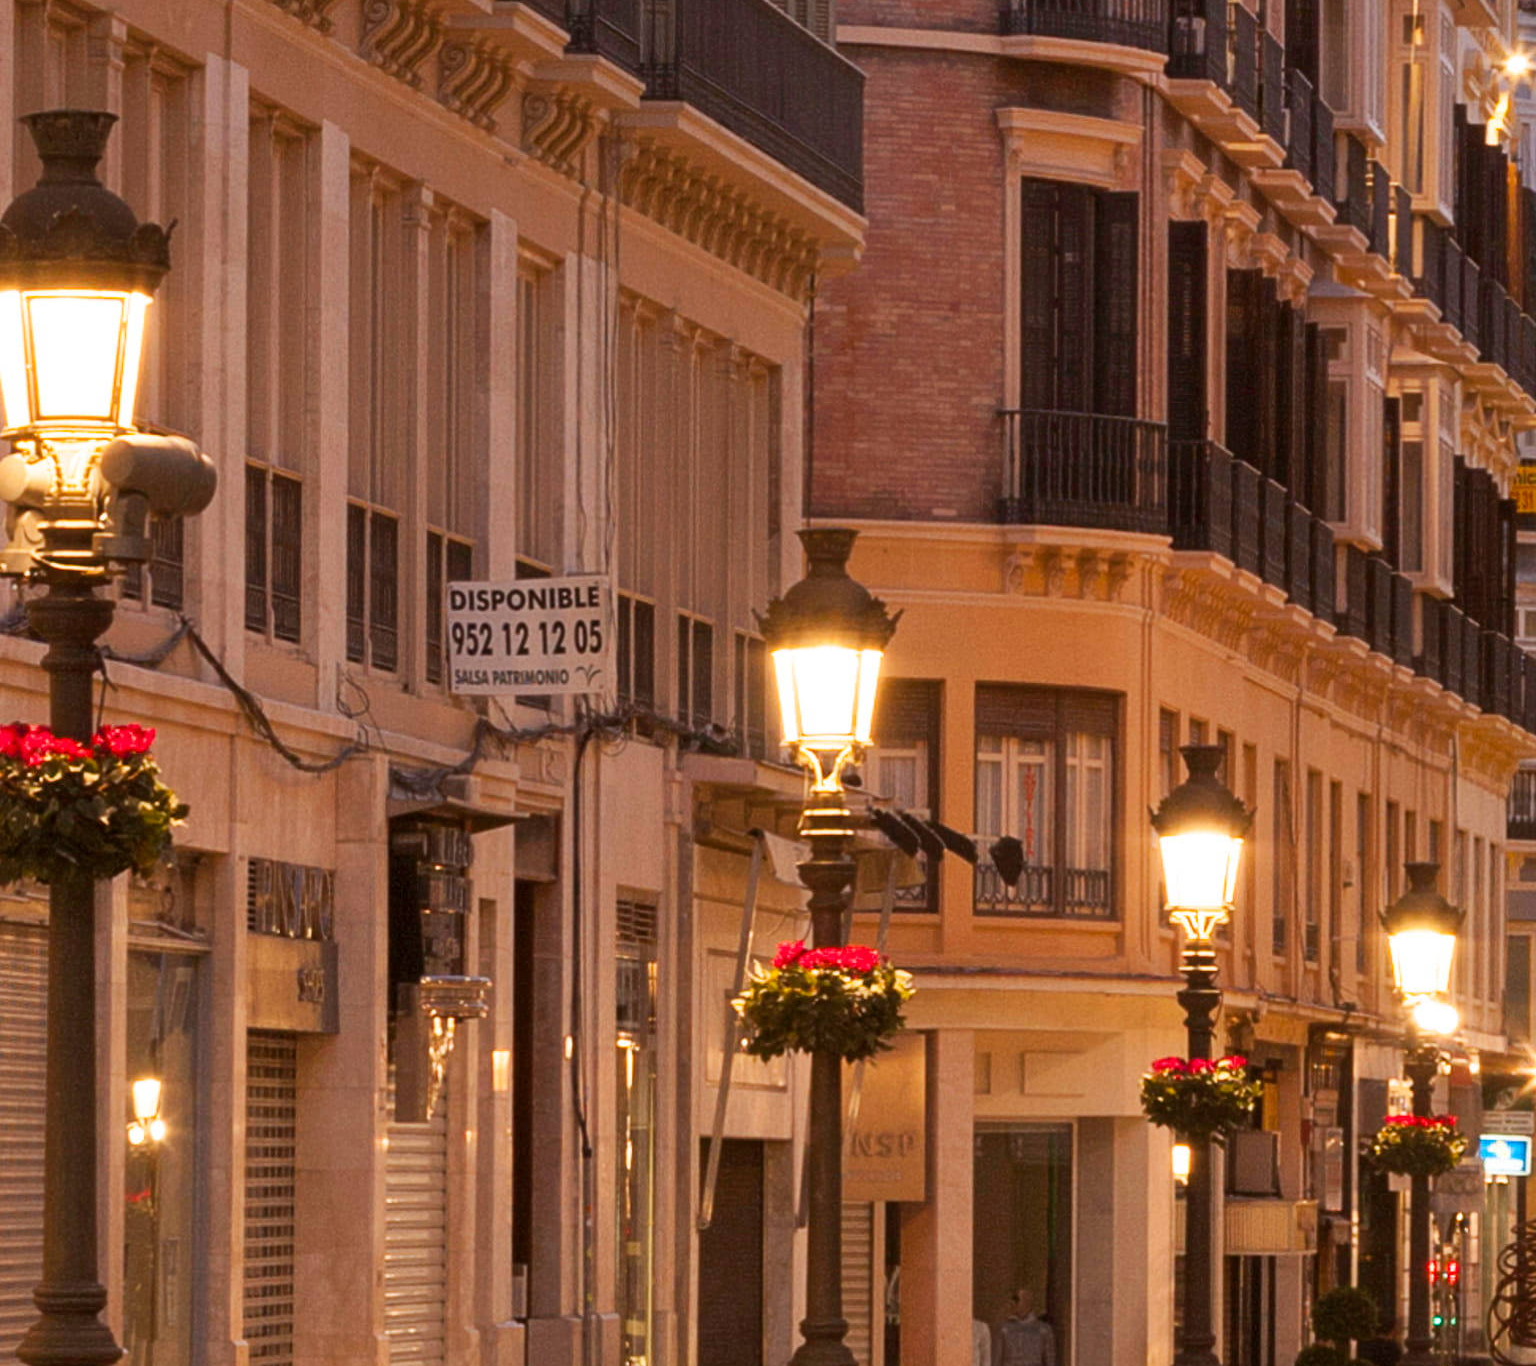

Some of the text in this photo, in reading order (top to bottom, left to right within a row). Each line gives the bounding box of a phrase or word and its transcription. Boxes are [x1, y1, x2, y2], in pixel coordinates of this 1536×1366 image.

[450, 586, 600, 612] DISPONIBLE
[451, 619, 602, 656] 952 12 12 05
[455, 668, 570, 685] SALSA PATRIMONIO
